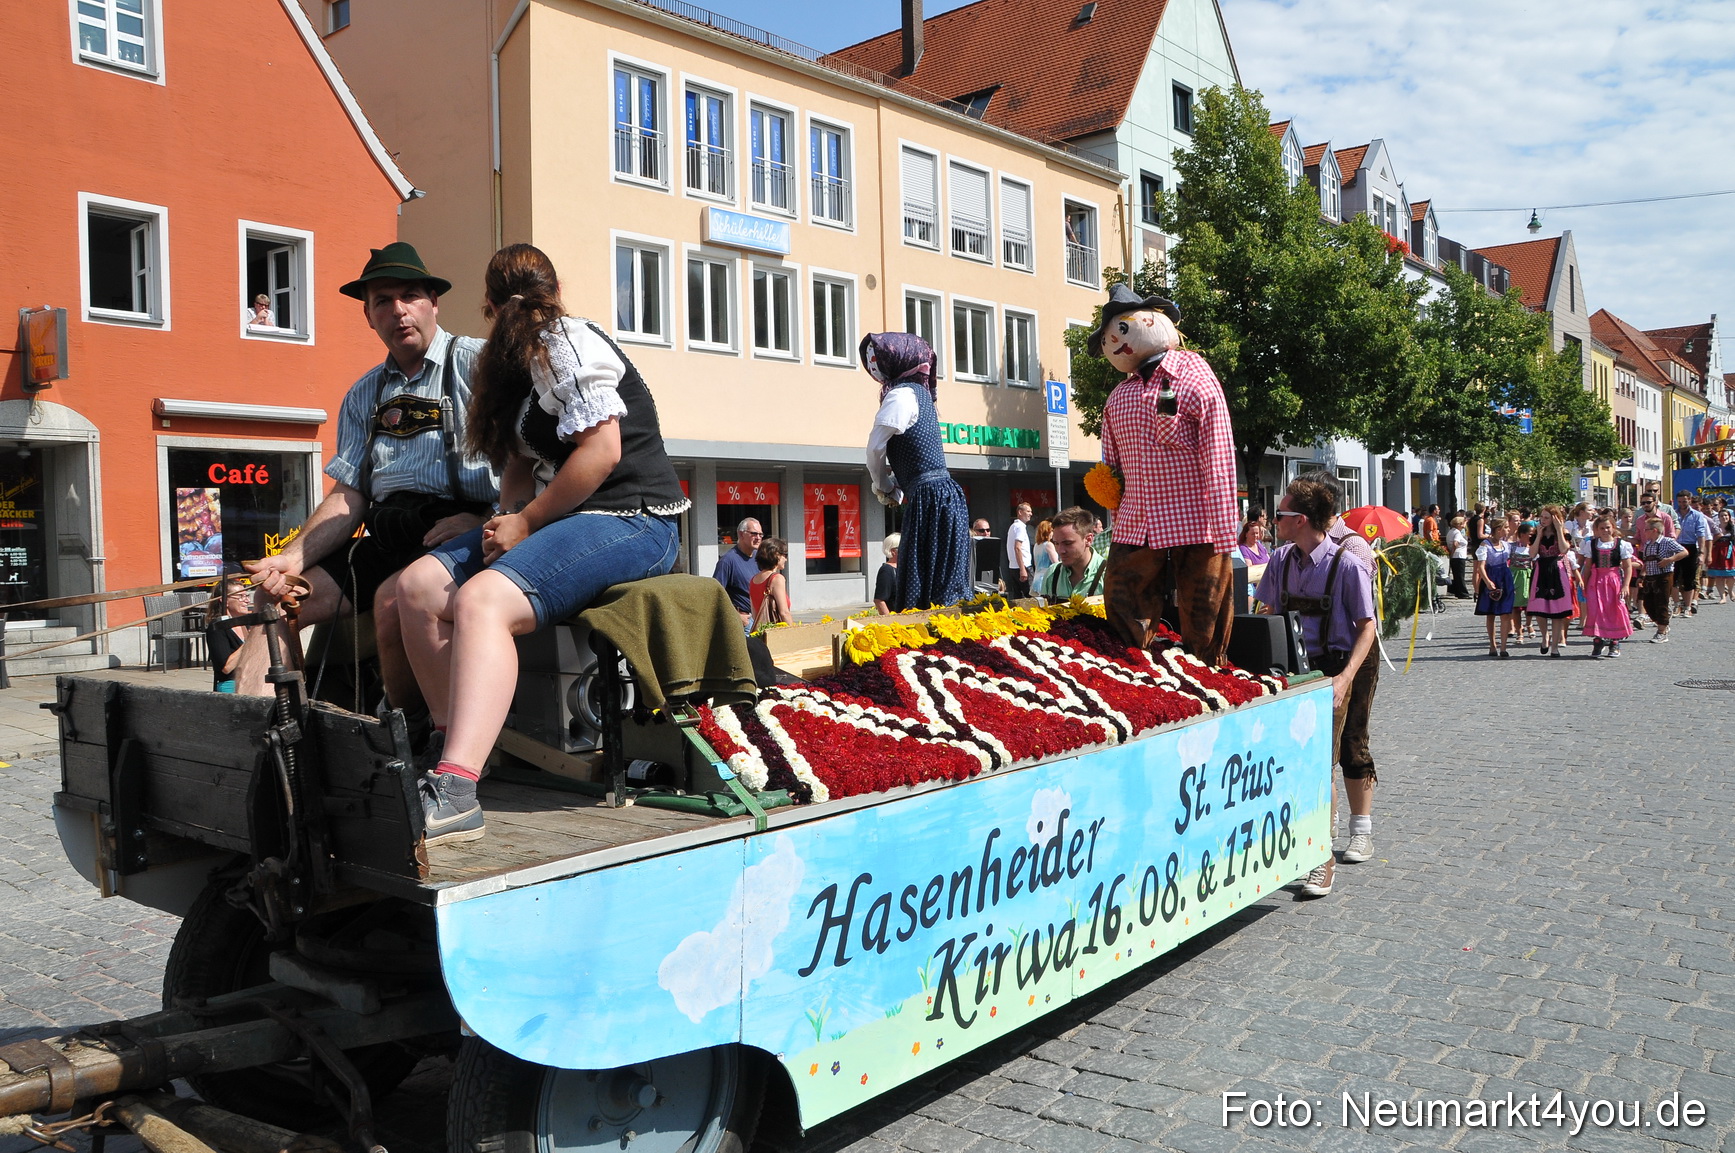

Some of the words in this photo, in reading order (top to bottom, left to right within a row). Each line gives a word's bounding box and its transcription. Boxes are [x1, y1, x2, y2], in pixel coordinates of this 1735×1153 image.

[1051, 385, 1063, 410] P
[939, 422, 1040, 449] EICHMANN
[208, 463, 269, 485] Café
[1703, 469, 1735, 487] KL
[1174, 763, 1211, 835] St.
[1221, 750, 1285, 810] Pius-
[797, 808, 1105, 977] Hasenheider
[925, 917, 1079, 1030] Kirwa
[1197, 849, 1218, 903] &
